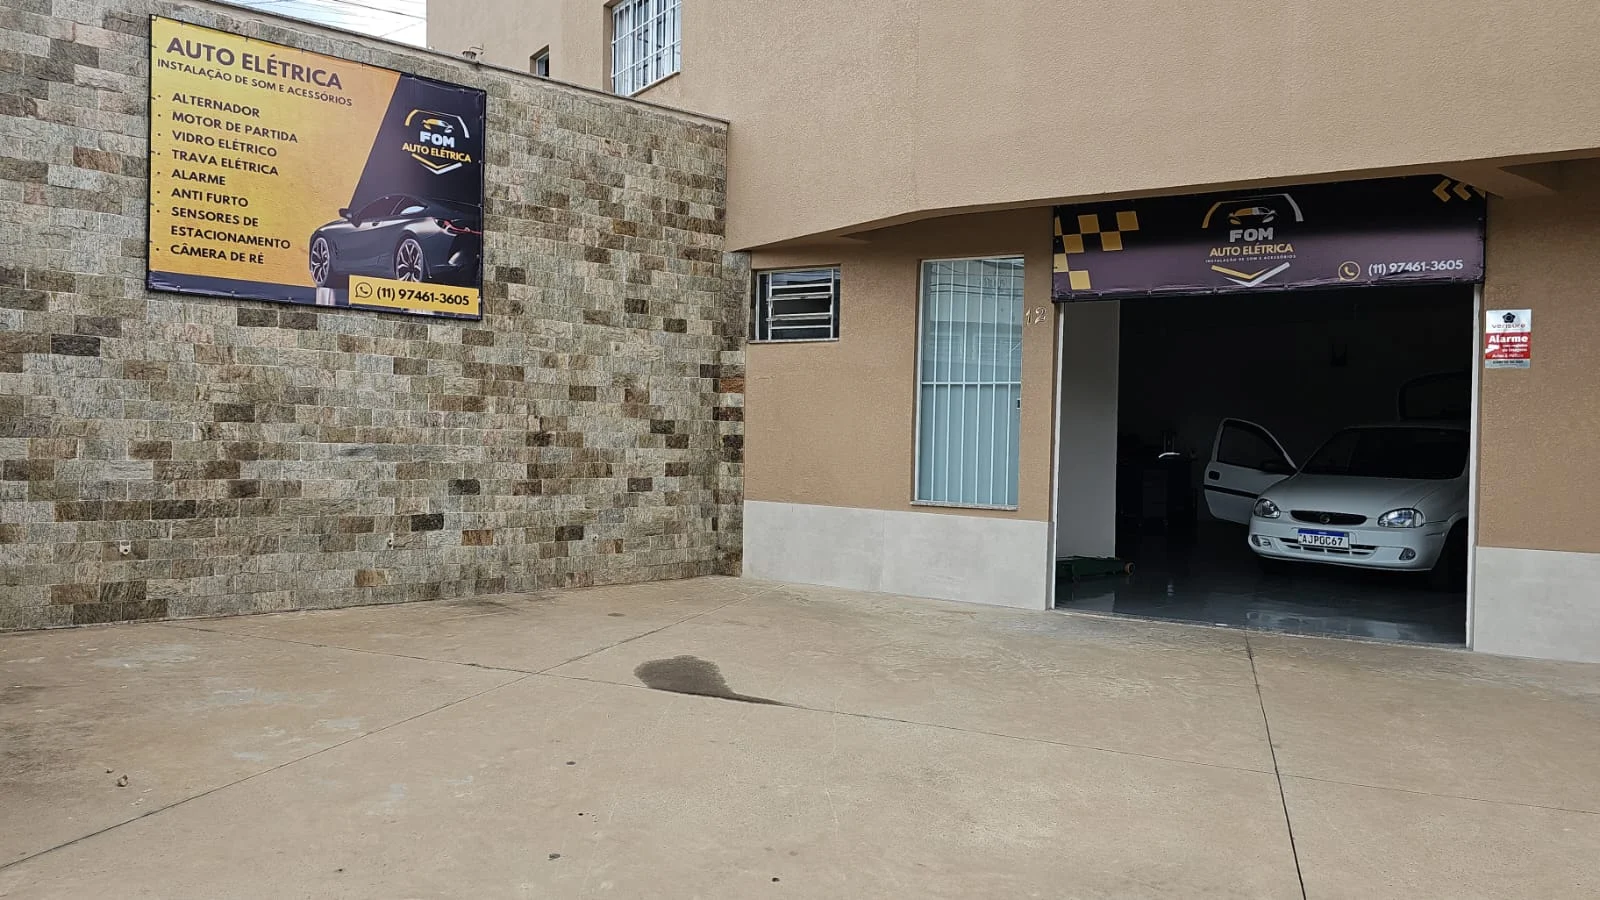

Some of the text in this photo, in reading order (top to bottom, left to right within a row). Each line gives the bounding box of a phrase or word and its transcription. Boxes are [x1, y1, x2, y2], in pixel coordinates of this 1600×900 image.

[166, 37, 342, 90] AUTO ELÉTRICA
[157, 58, 352, 106] INSTALAÇÃO DE SOM E ACESSÓRIOS
[172, 92, 260, 118] ALTERNADOR
[172, 111, 298, 143] MOTOR DE PARTIDA
[172, 130, 277, 157] VIDRO ELÉTRICO
[420, 131, 455, 148] FOM
[172, 149, 279, 176] TRAVA ELÉTRICA
[402, 142, 472, 163] AUTO ELÉTRICA
[171, 169, 226, 186] ALARME
[171, 188, 249, 208] ANTI FURTO
[171, 206, 259, 227] SENSORES DE
[171, 226, 291, 250] ESTACIONAMENTO
[1229, 227, 1274, 243] FOM
[170, 242, 264, 264] CÂMERA DE RÉ
[1209, 242, 1294, 257] AUTO ELÉTRICA
[1368, 260, 1464, 277] (11) 97461-3605
[376, 286, 470, 306] (11) 97461-3605
[1026, 306, 1047, 326] 12
[1488, 334, 1529, 344] Alarme
